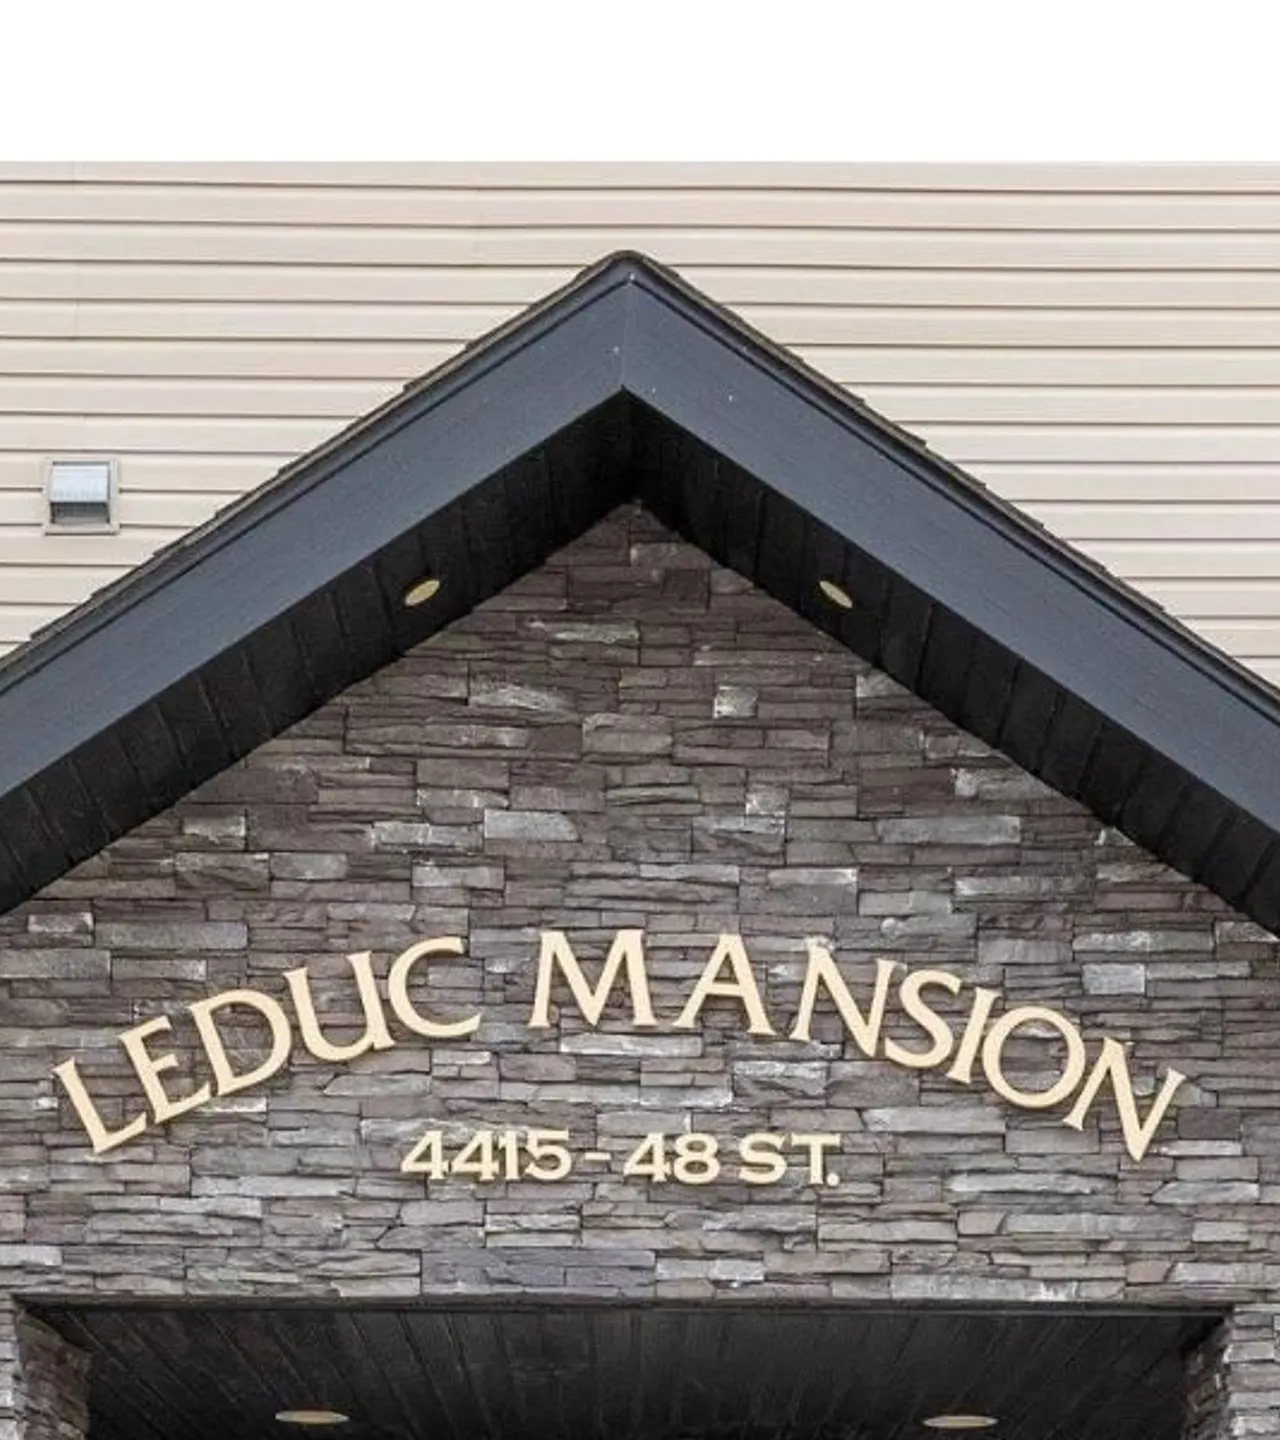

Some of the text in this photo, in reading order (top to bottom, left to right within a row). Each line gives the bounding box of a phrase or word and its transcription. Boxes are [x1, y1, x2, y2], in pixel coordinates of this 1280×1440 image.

[54, 928, 1186, 1161] LEDUC MANSION
[738, 1132, 841, 1186] ST.
